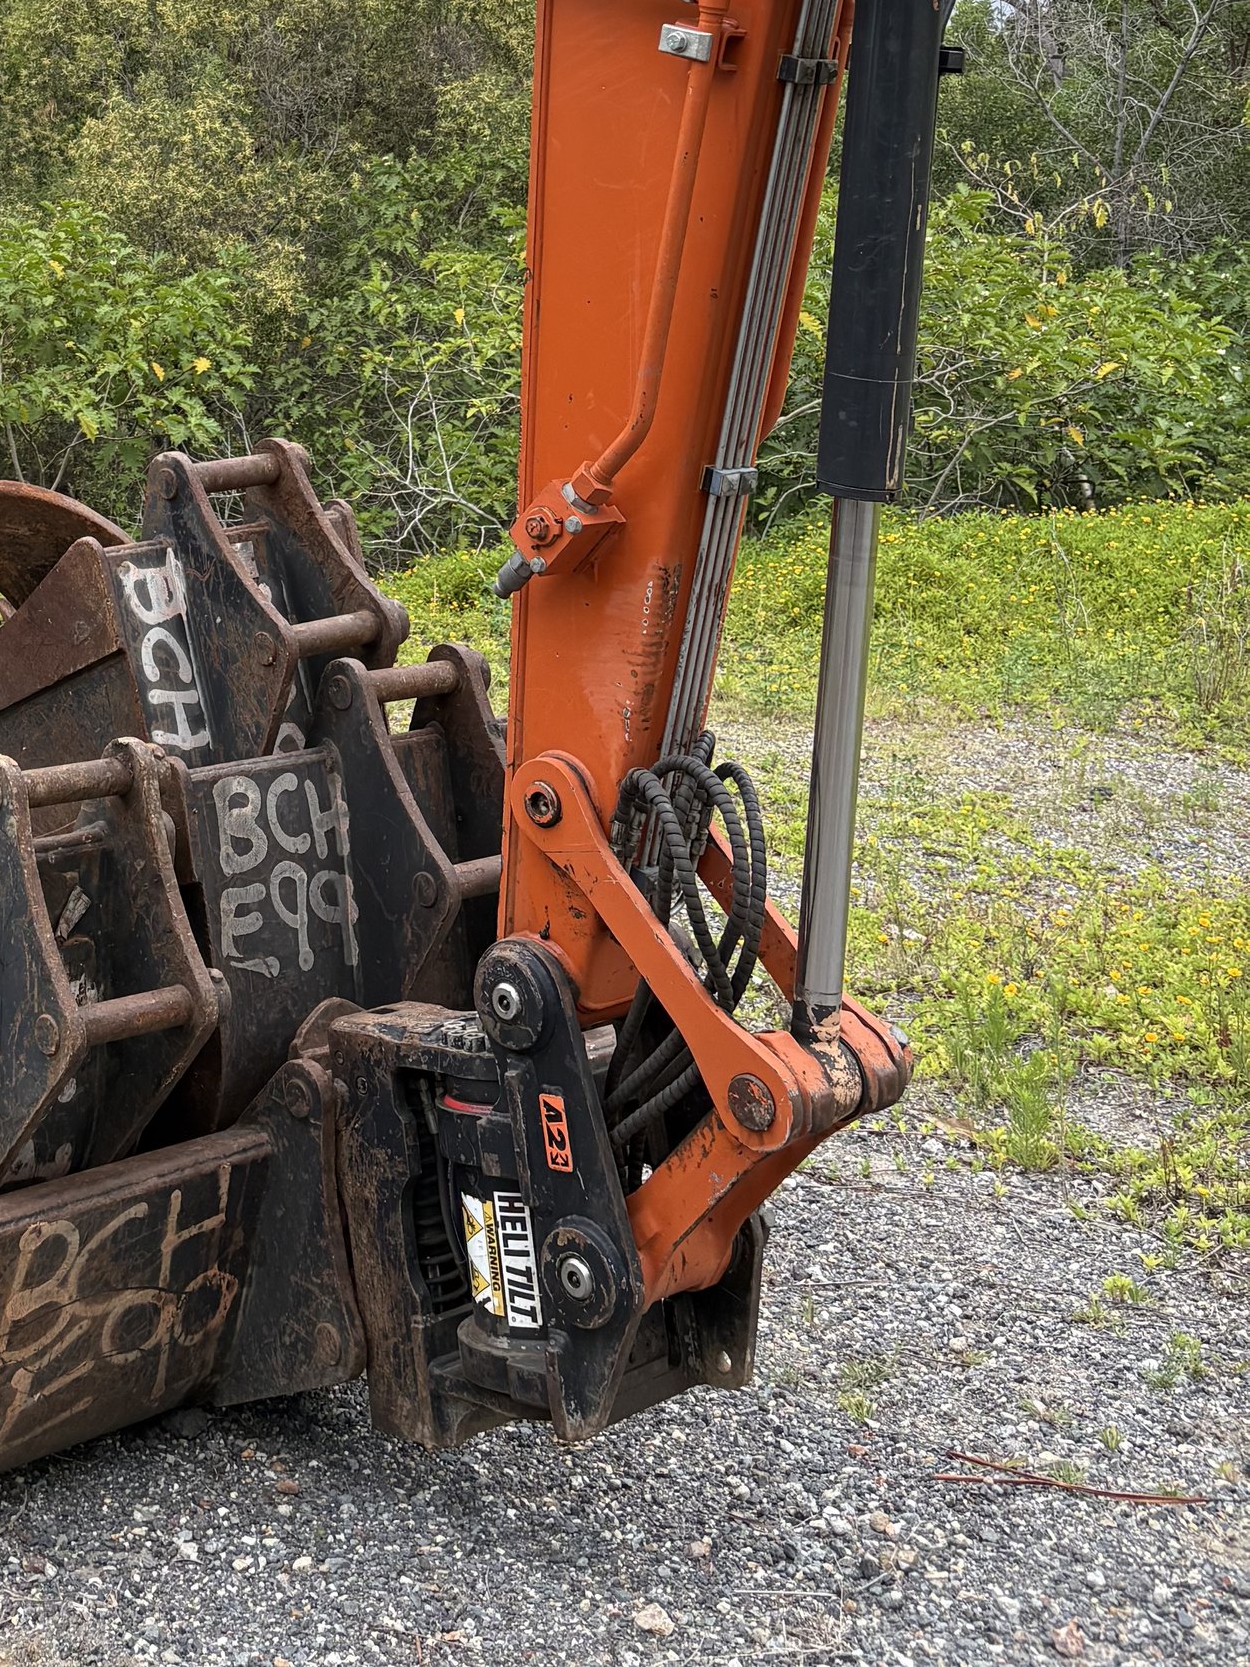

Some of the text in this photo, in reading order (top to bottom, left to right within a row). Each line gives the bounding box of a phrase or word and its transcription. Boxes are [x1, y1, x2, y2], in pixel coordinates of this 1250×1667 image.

[118, 547, 211, 751] BCH
[212, 772, 350, 876] BCH
[485, 1223, 500, 1292] WARNING
[497, 1194, 539, 1325] HELI TILT
